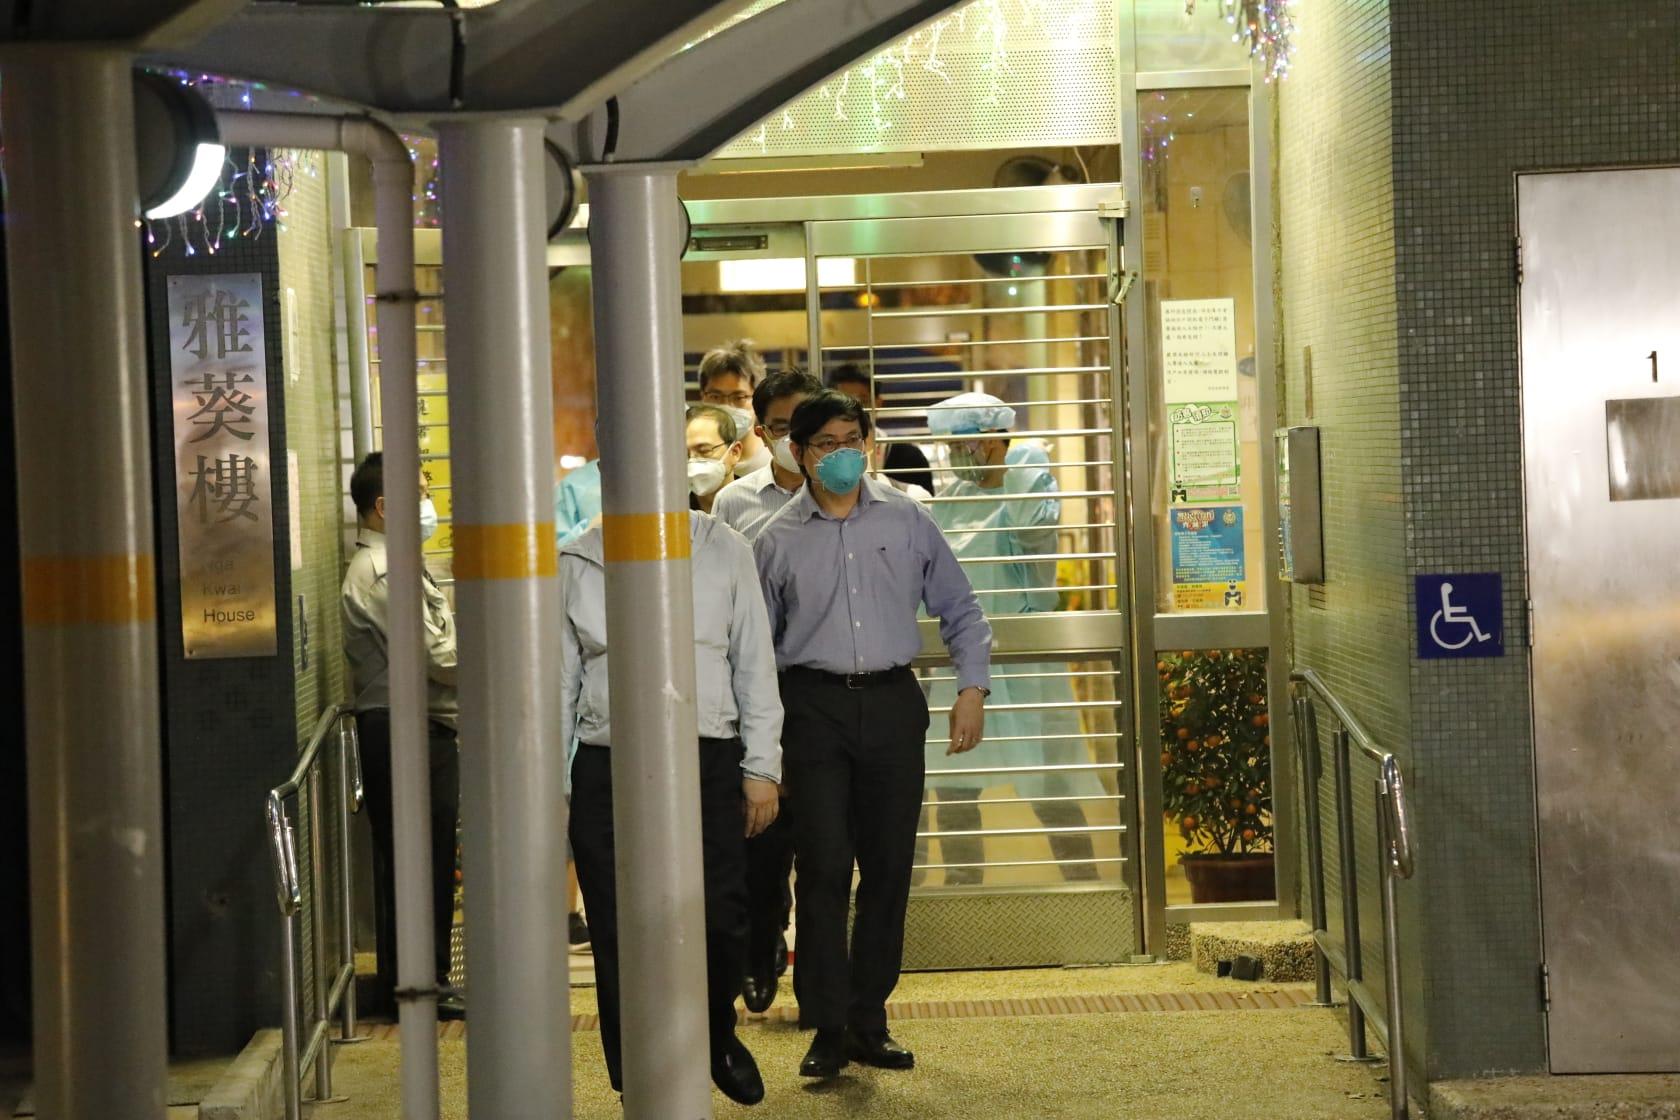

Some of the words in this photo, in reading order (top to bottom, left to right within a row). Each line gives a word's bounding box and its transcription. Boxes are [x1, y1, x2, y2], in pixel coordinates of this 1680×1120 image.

[1646, 350, 1658, 383] 1
[182, 290, 259, 524] 雅葵樓
[203, 608, 256, 623] House
